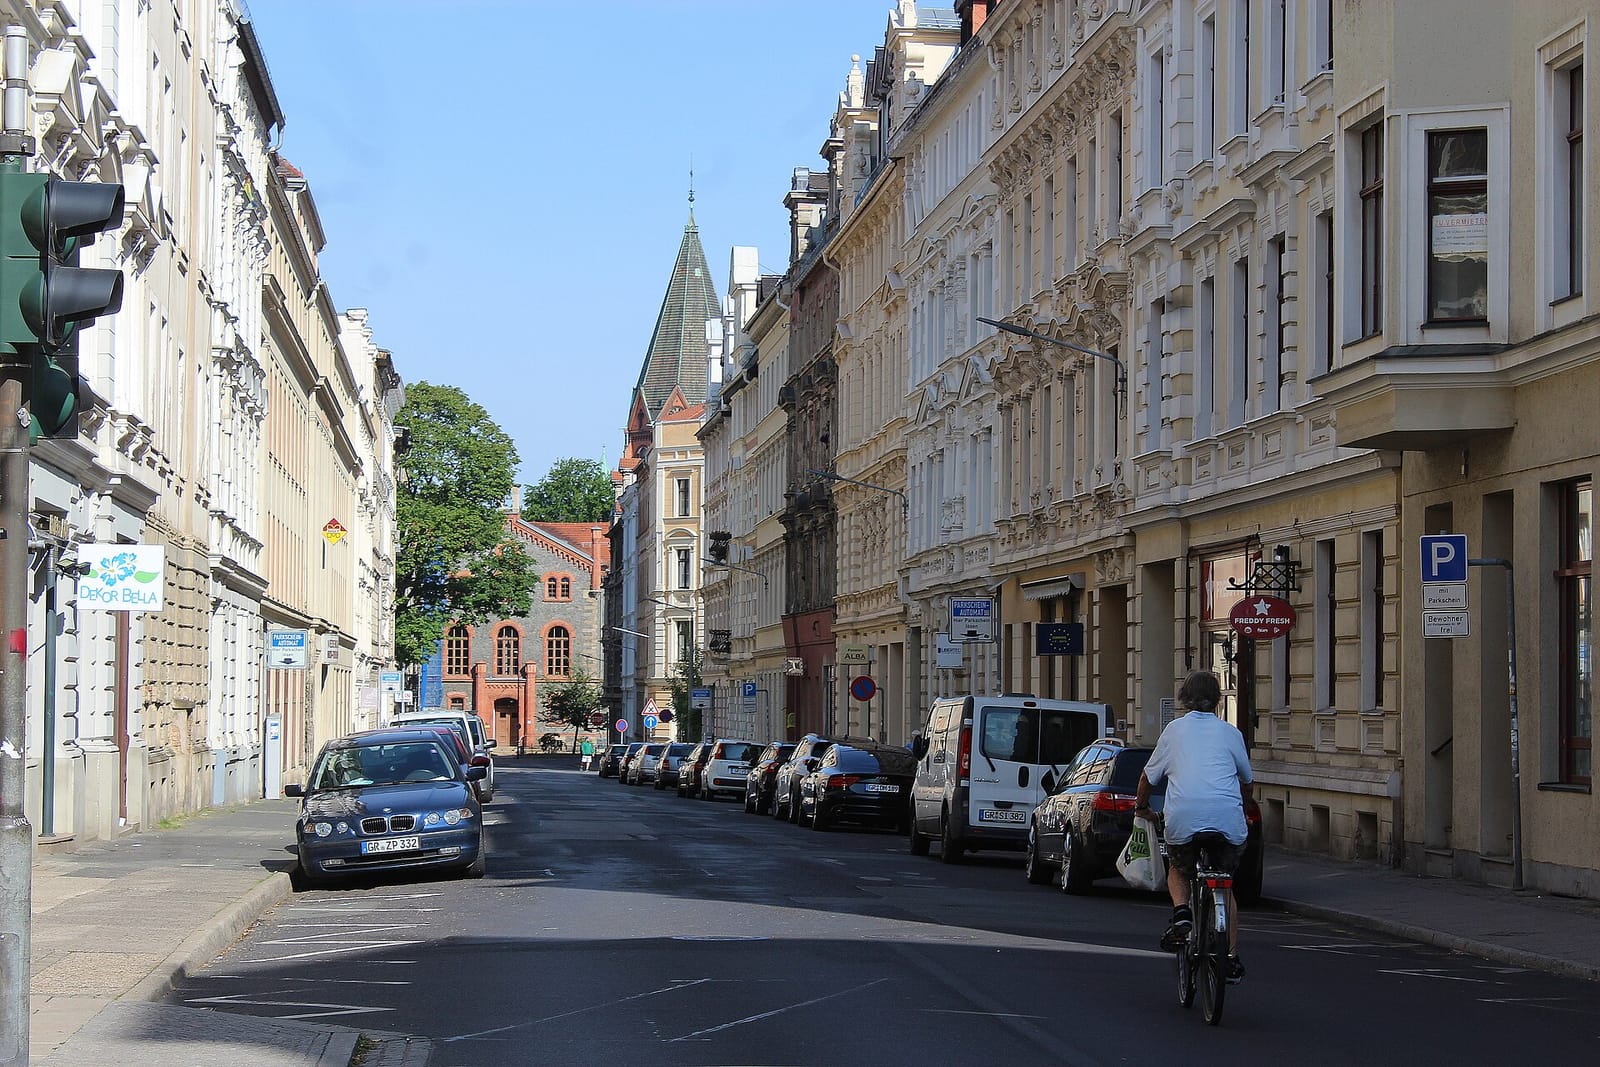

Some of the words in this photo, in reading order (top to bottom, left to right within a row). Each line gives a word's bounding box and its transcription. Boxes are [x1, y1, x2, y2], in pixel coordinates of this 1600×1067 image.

[1431, 542, 1455, 577] P
[80, 585, 118, 603] DEKOR
[122, 588, 158, 604] BELLA
[1428, 615, 1464, 623] Bewohner
[1440, 626, 1453, 634] frei
[745, 684, 754, 696] P
[984, 811, 994, 819] GR
[1009, 812, 1024, 820] 382
[367, 842, 380, 852] GR
[386, 841, 398, 850] ZP
[400, 839, 417, 849] 332
